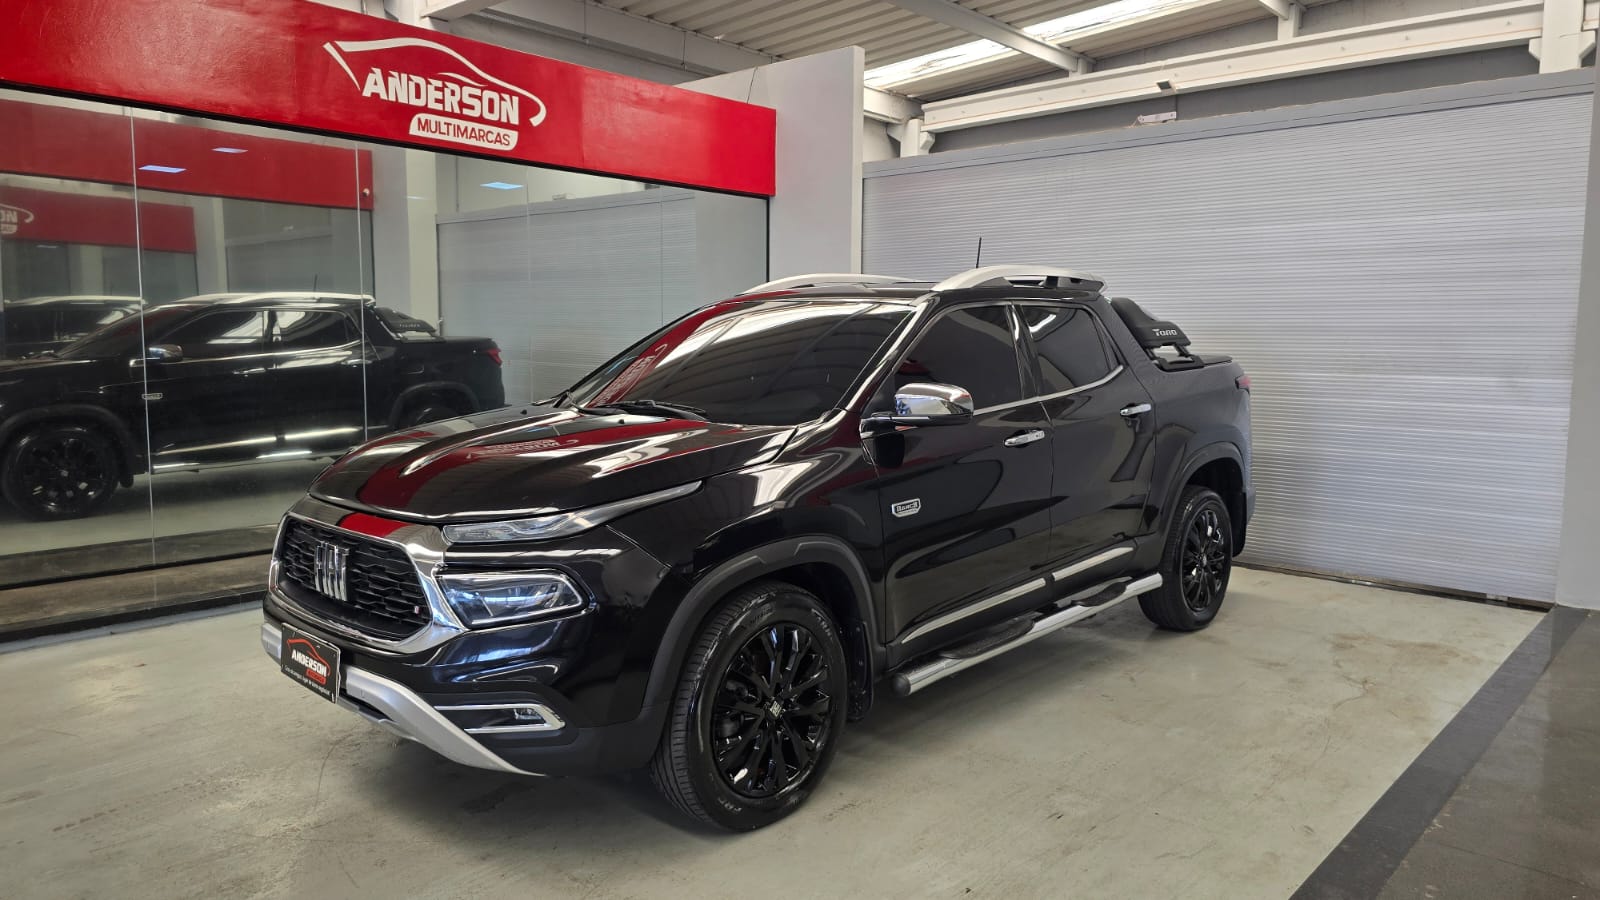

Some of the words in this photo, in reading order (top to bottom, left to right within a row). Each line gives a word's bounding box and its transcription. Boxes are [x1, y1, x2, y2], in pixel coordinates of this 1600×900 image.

[362, 67, 519, 125] ANDERSON
[417, 117, 511, 146] MULTIMARCAS
[1152, 328, 1178, 337] TORO
[291, 649, 328, 678] ANDERSON
